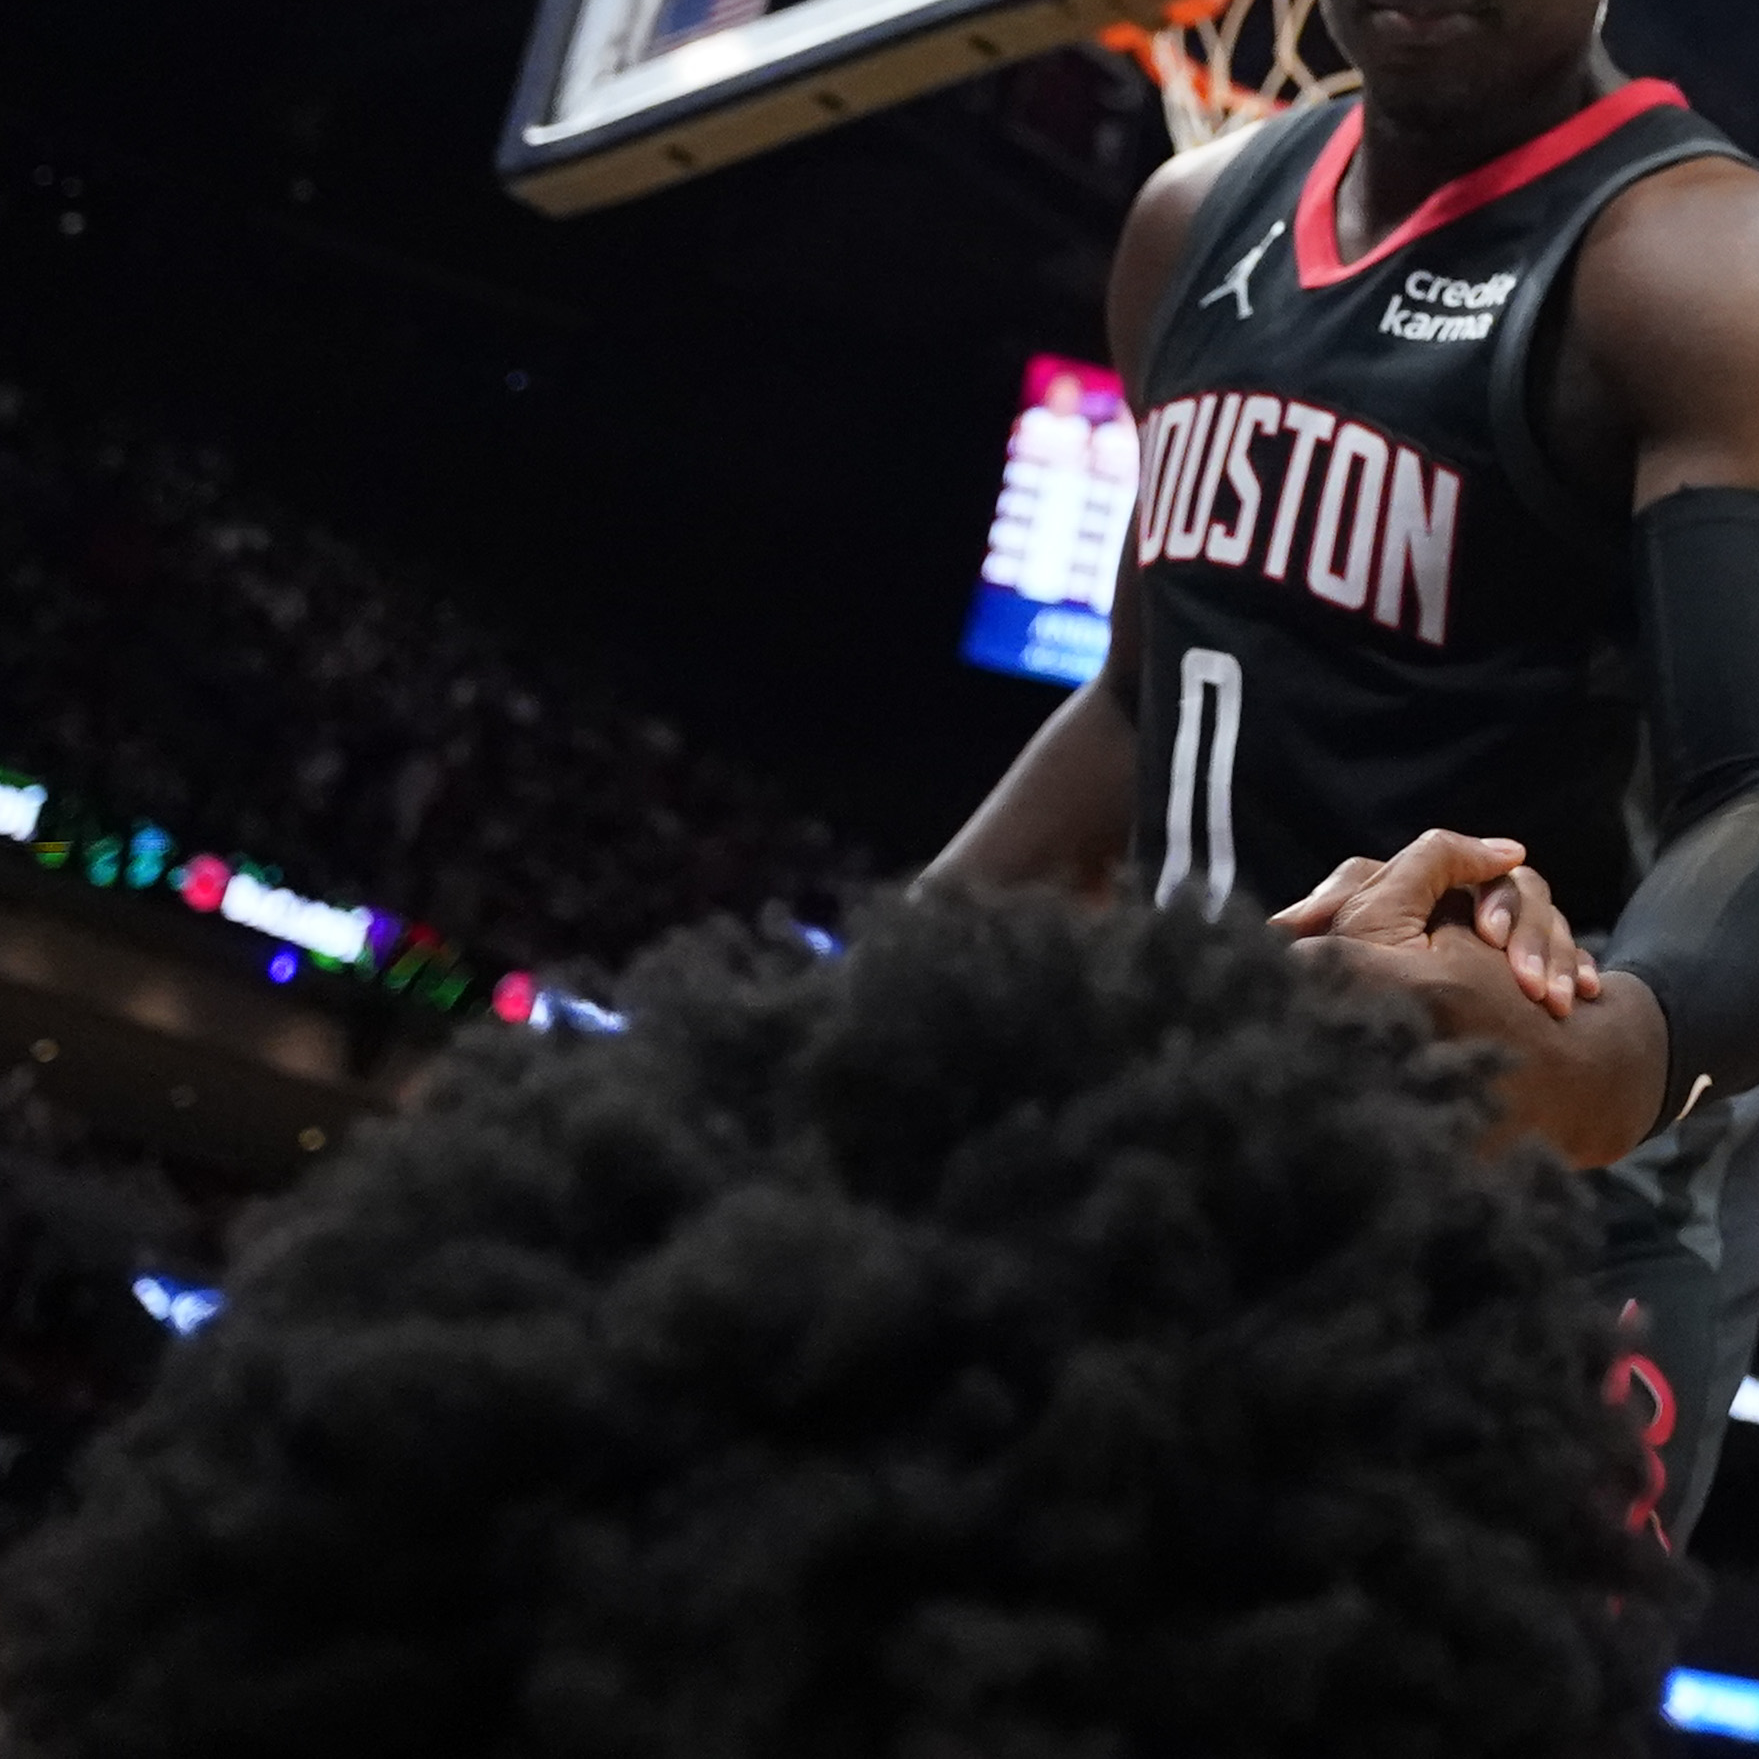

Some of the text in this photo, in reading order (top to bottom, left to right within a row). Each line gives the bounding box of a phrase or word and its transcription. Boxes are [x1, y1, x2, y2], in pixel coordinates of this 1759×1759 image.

[1377, 293, 1495, 343] karma
[1405, 264, 1518, 310] credit
[1138, 390, 1463, 646] OUSTON
[1154, 647, 1243, 924] 0
